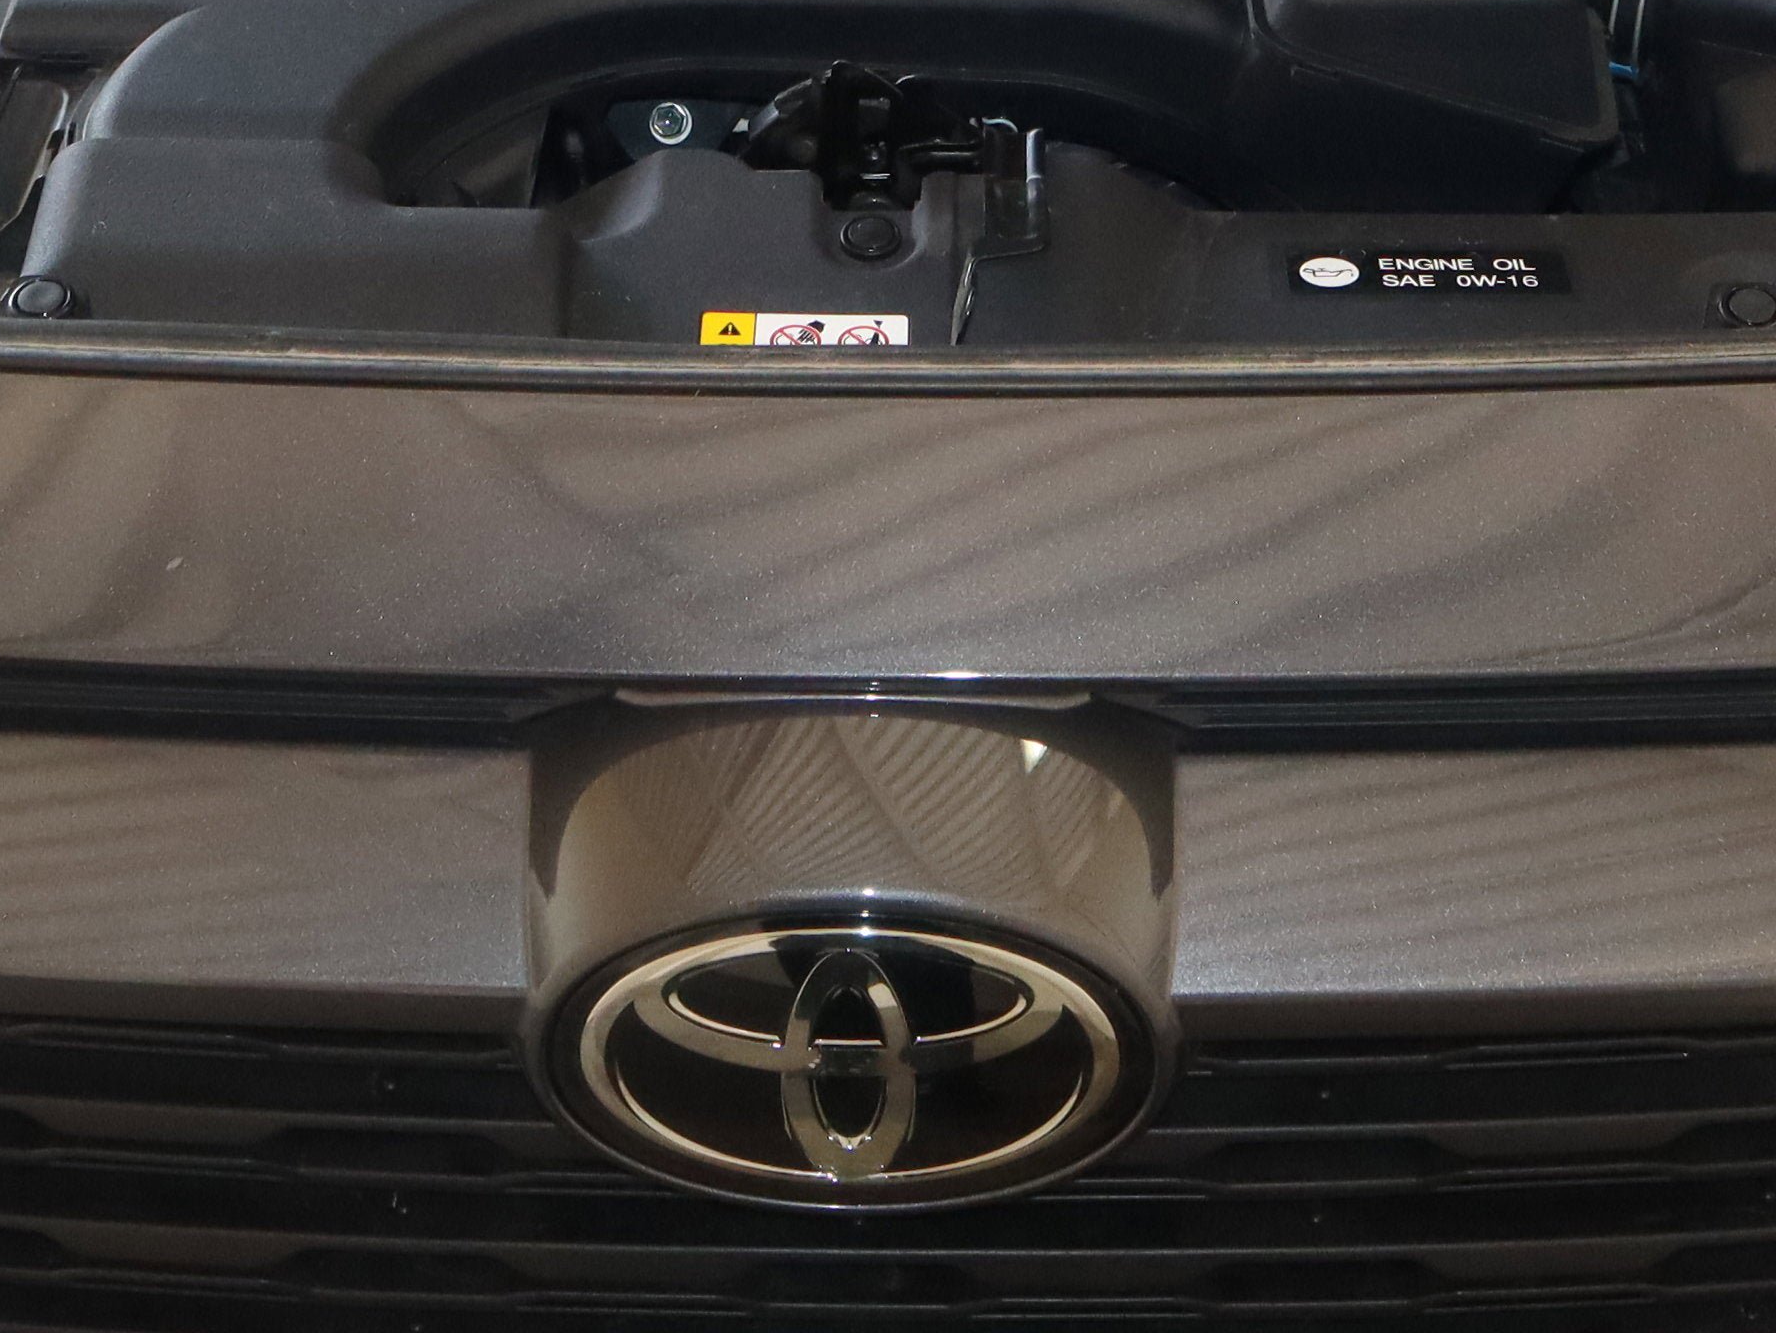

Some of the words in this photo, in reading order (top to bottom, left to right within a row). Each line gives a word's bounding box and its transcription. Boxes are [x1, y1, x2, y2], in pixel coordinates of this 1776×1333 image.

[1377, 257, 1475, 272] ENGINE
[1492, 257, 1537, 272] OIL
[1382, 274, 1437, 288] SAE
[1456, 274, 1540, 288] 0W-16
